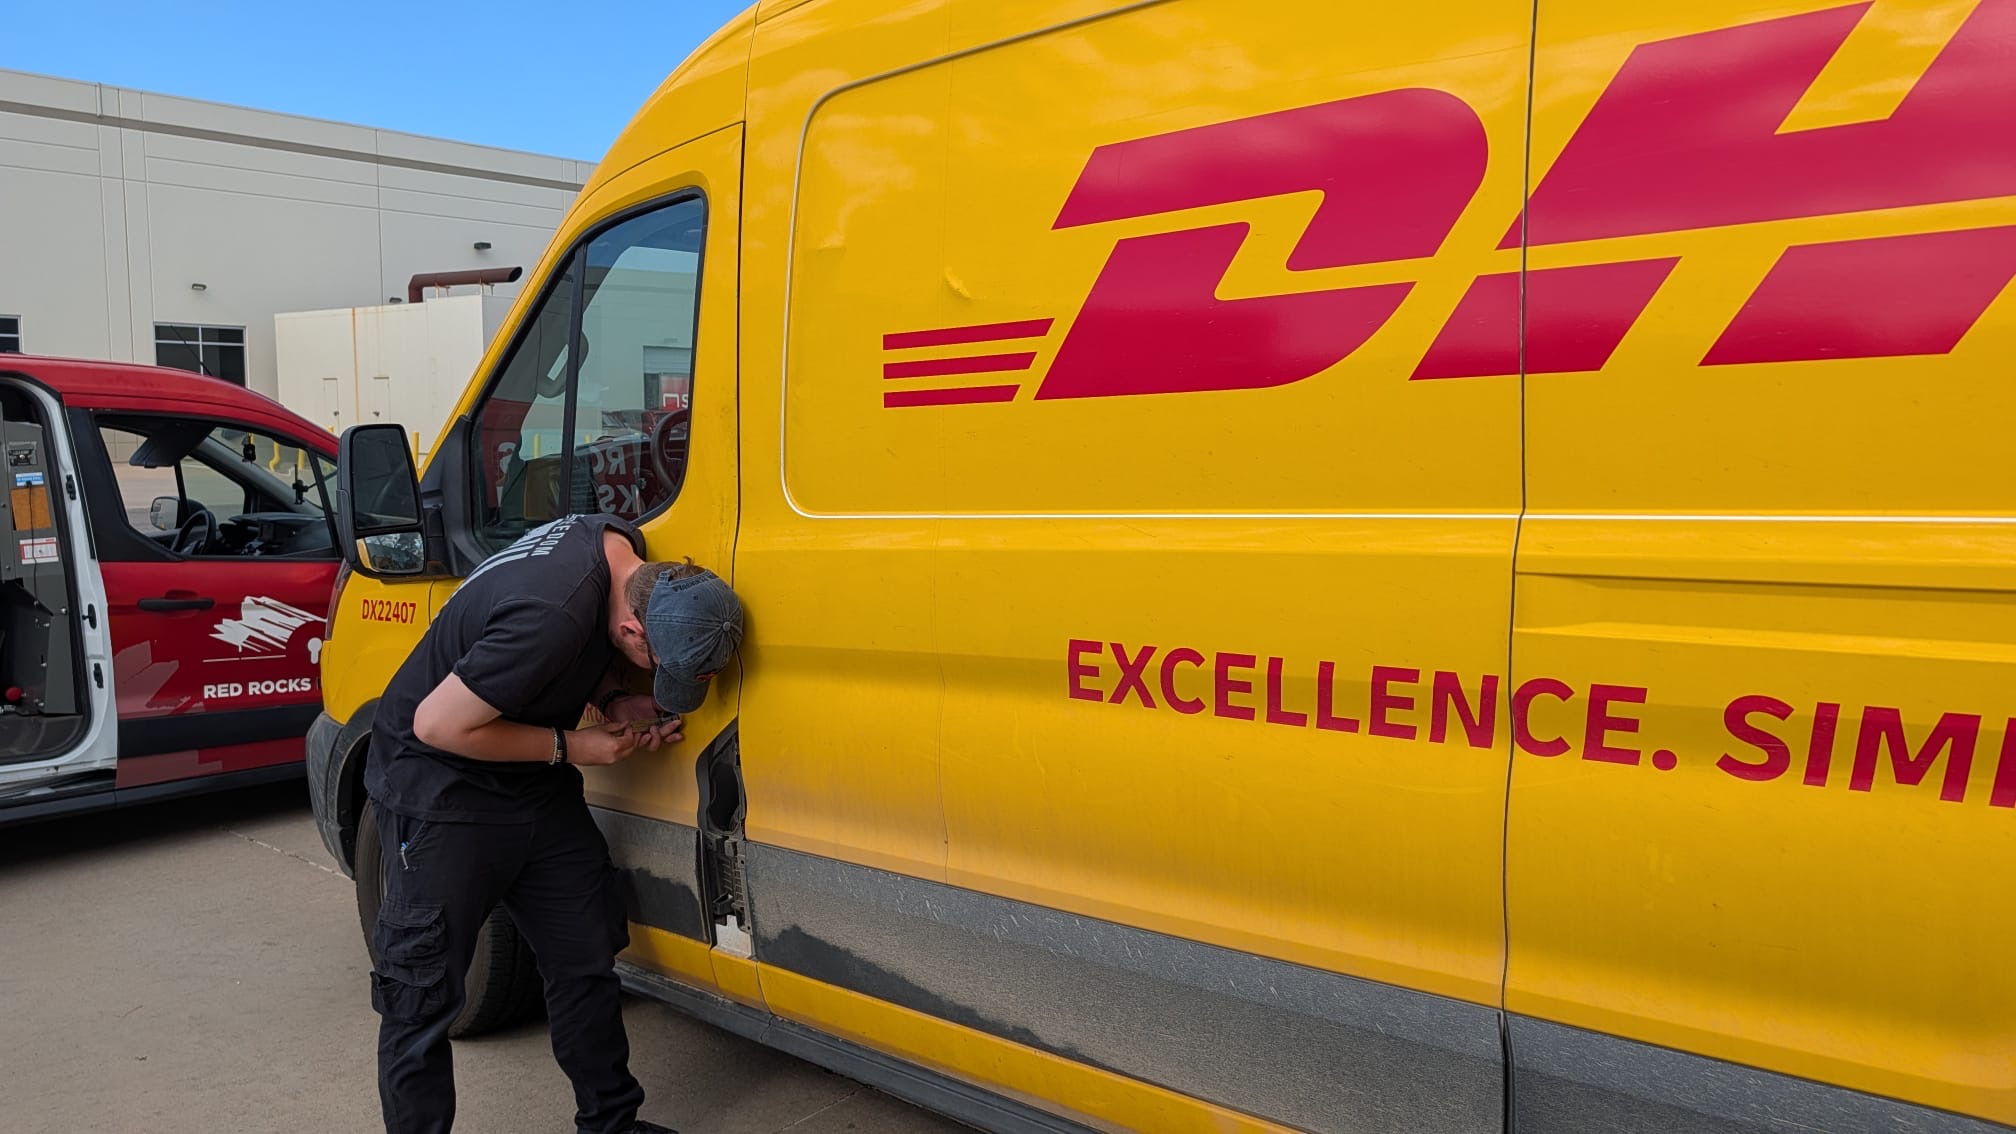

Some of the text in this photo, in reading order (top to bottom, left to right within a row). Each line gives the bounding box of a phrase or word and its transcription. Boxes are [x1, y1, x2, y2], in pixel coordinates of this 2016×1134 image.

[362, 599, 417, 624] DX22407
[203, 683, 243, 699] RED
[248, 678, 312, 696] ROCKS
[1067, 638, 1678, 771] EXCELLENCE.
